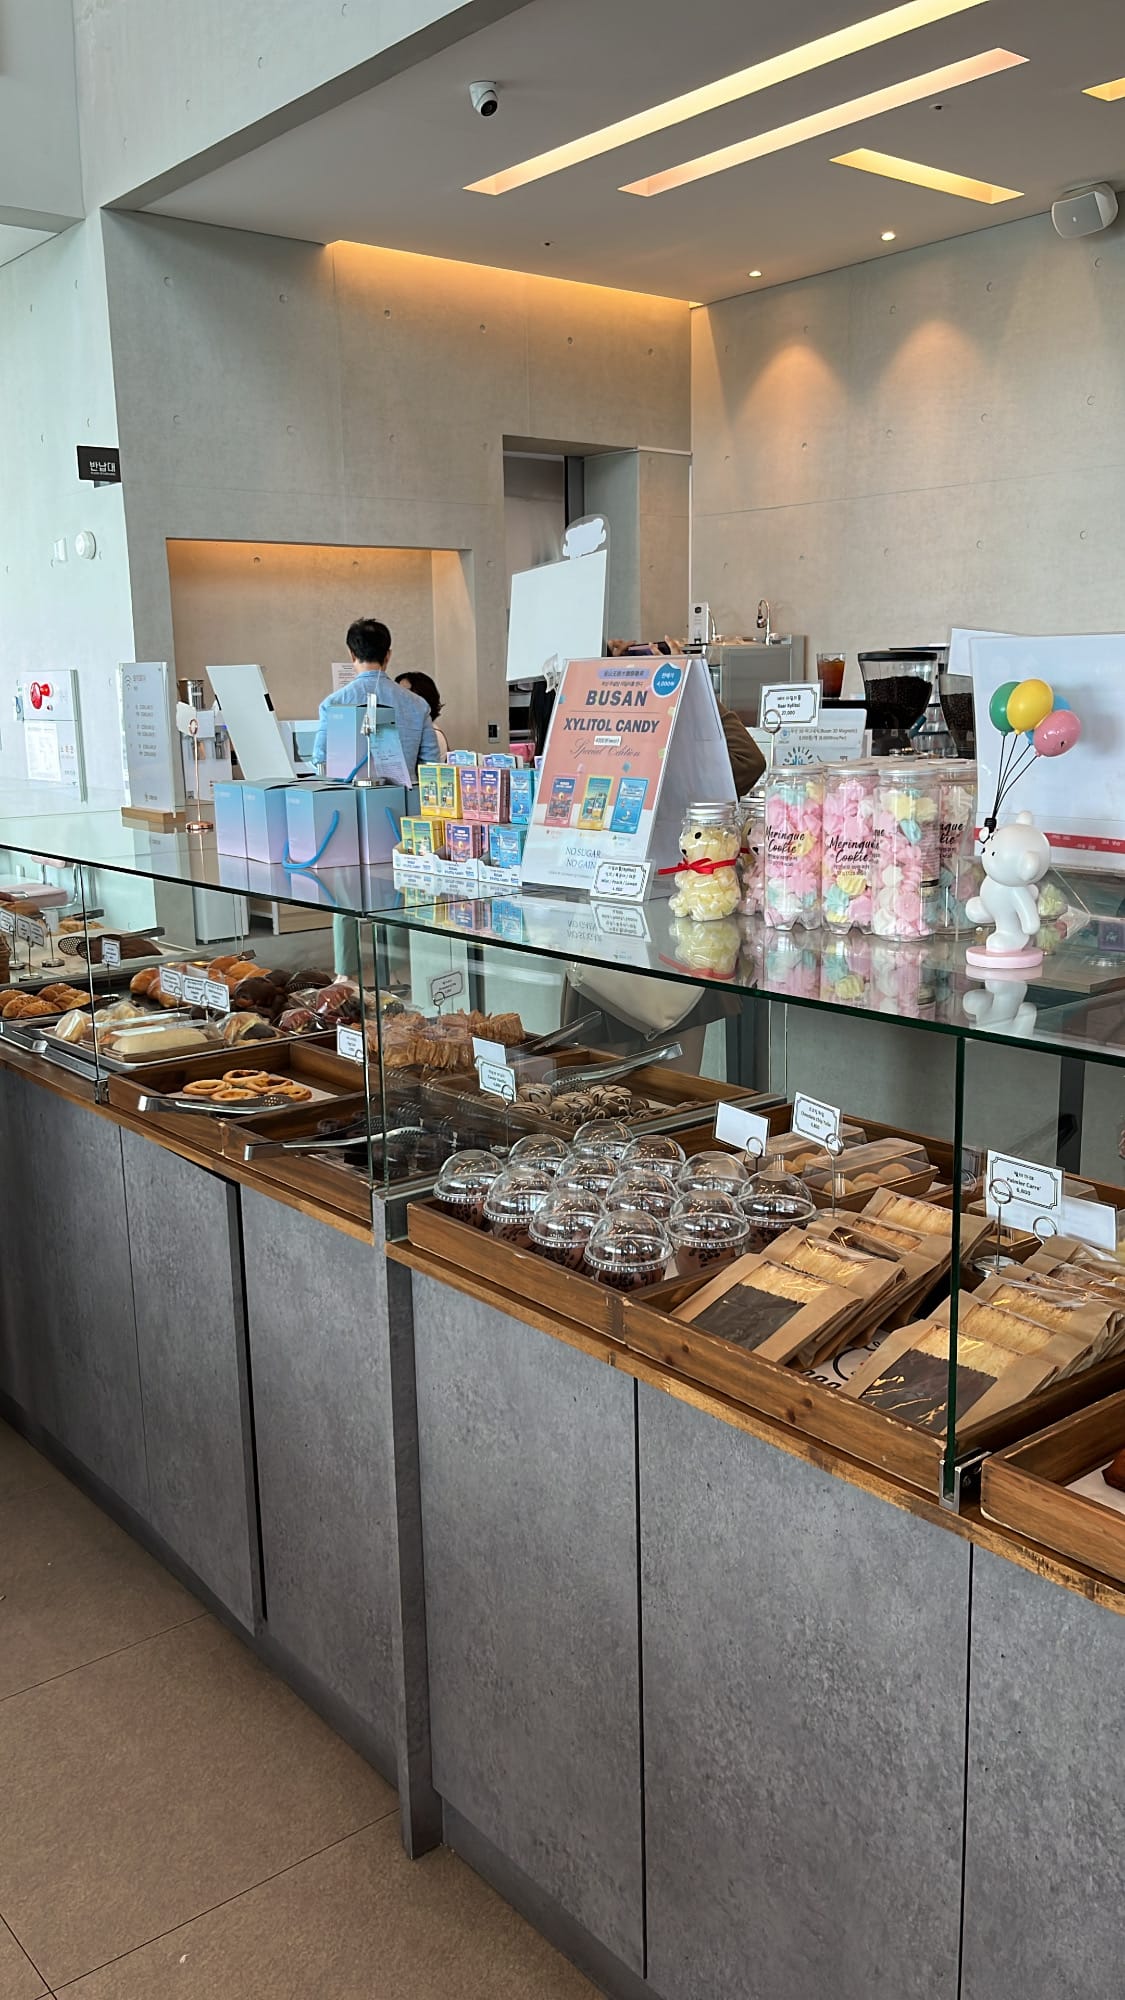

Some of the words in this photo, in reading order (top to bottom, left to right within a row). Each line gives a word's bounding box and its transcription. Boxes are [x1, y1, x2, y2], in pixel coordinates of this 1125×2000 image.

[90, 461, 116, 473] 반납대
[586, 690, 648, 706] BUSAN
[564, 717, 612, 731] XYLITOL
[616, 719, 660, 733] CANDY
[766, 825, 805, 844] Meringue
[768, 839, 797, 853] Cookie
[829, 835, 875, 852] Meringue
[835, 849, 869, 863] Cookie
